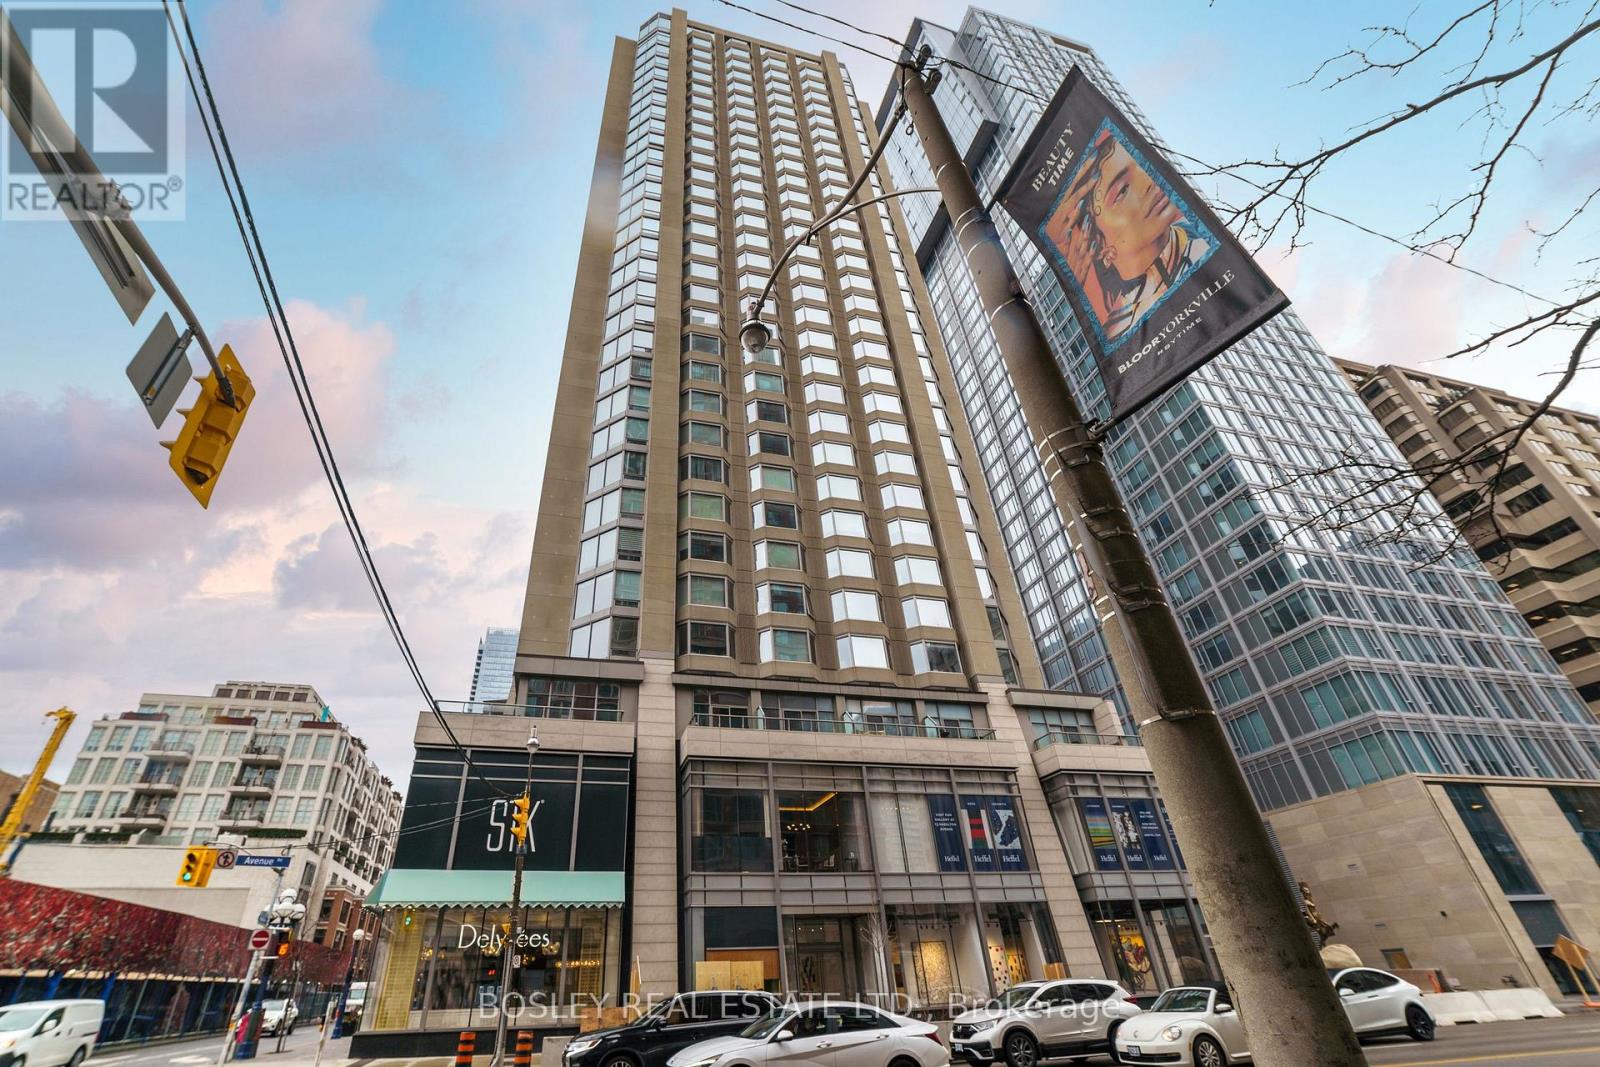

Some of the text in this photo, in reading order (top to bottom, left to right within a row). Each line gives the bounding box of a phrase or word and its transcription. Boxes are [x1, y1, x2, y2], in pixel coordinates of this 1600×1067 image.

[1032, 120, 1073, 191] BEAUTY
[1048, 147, 1074, 186] TIME
[1117, 269, 1235, 374] BLOORYORKVILLE
[244, 857, 274, 865] Avenue
[457, 924, 550, 953] Delyées
